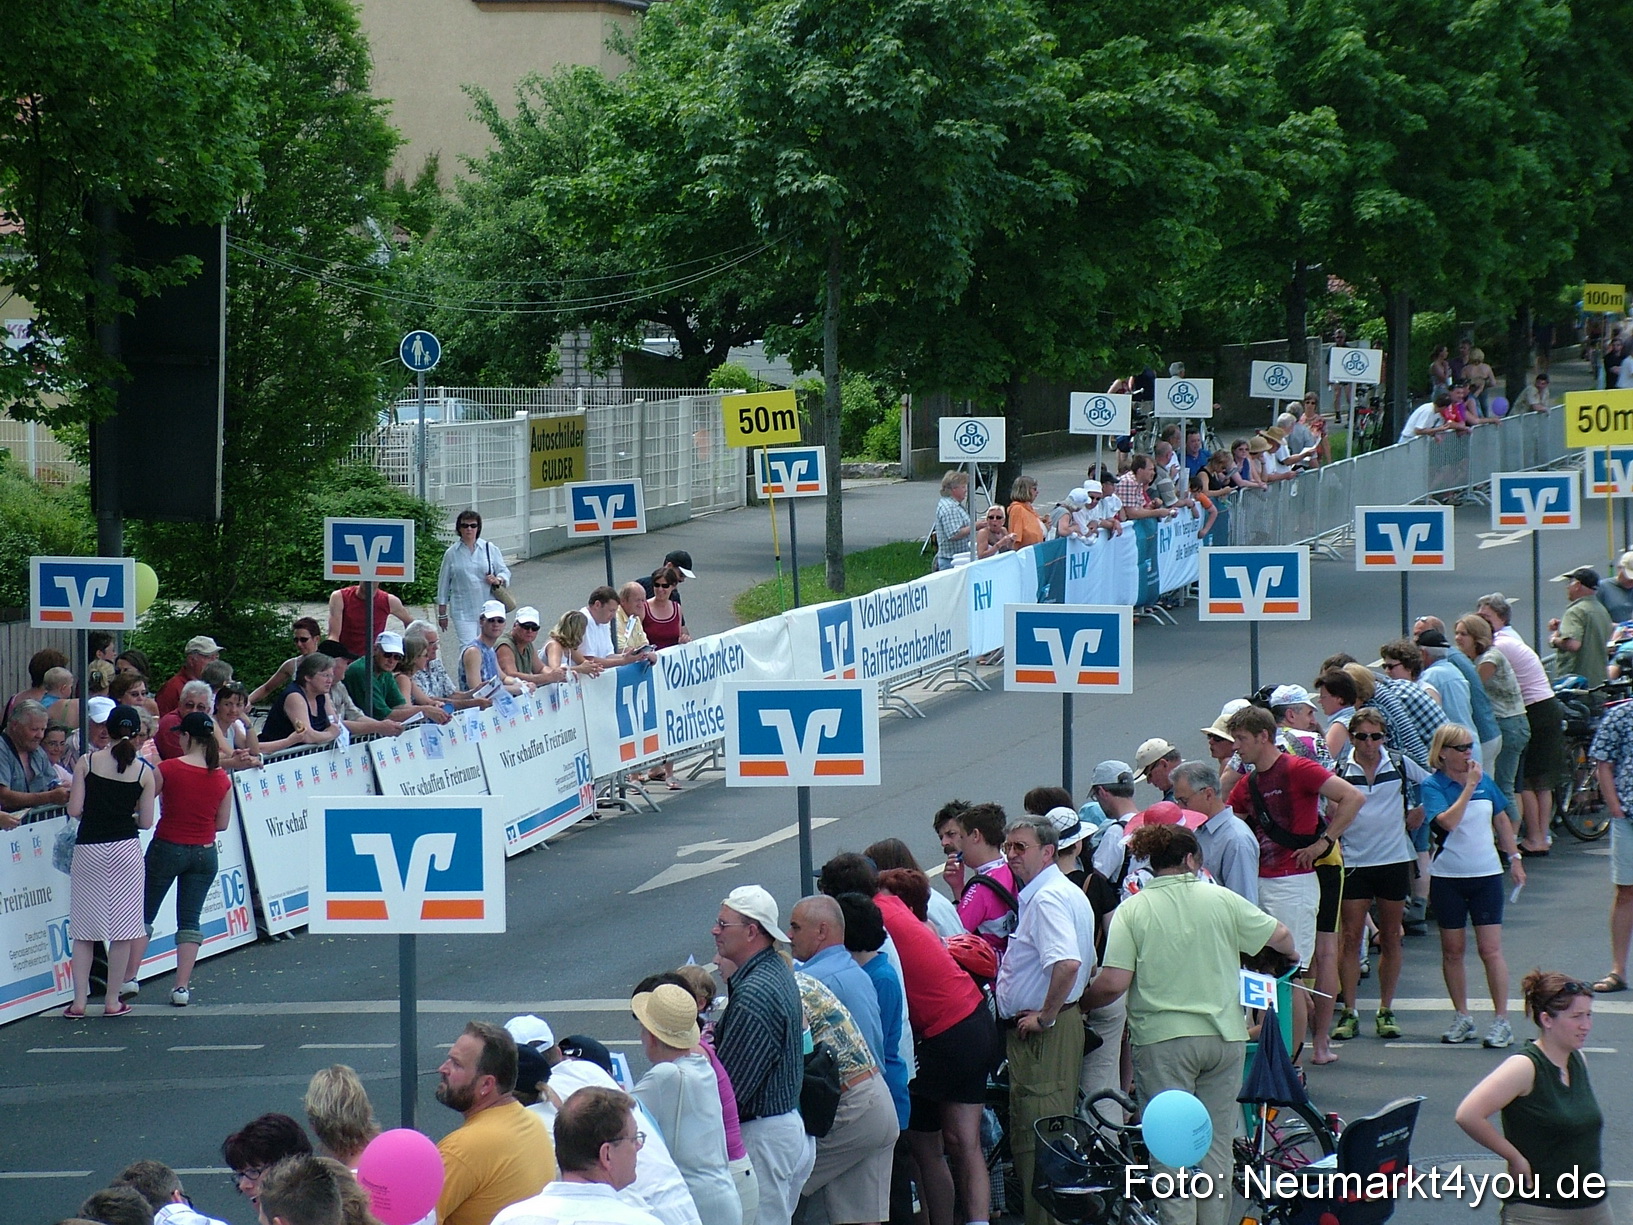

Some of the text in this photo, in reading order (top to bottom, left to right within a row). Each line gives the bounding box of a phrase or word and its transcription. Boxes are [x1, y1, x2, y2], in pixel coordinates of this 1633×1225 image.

[1586, 291, 1624, 306] 100m
[739, 406, 796, 435] 50m
[1578, 403, 1633, 433] 50m
[530, 421, 584, 453] Autoschilder
[859, 584, 928, 630] Volksbanken
[661, 638, 744, 691] Volksbanken
[862, 623, 952, 679] Raiffeisenbanken
[665, 698, 725, 746] Raiffeise
[500, 727, 577, 769] Wir schaffen Freiräume
[400, 781, 416, 796] Wir
[416, 772, 446, 796] schaffen
[265, 808, 308, 838] Wir schaf
[220, 869, 245, 909] DG
[226, 906, 249, 937] HYP
